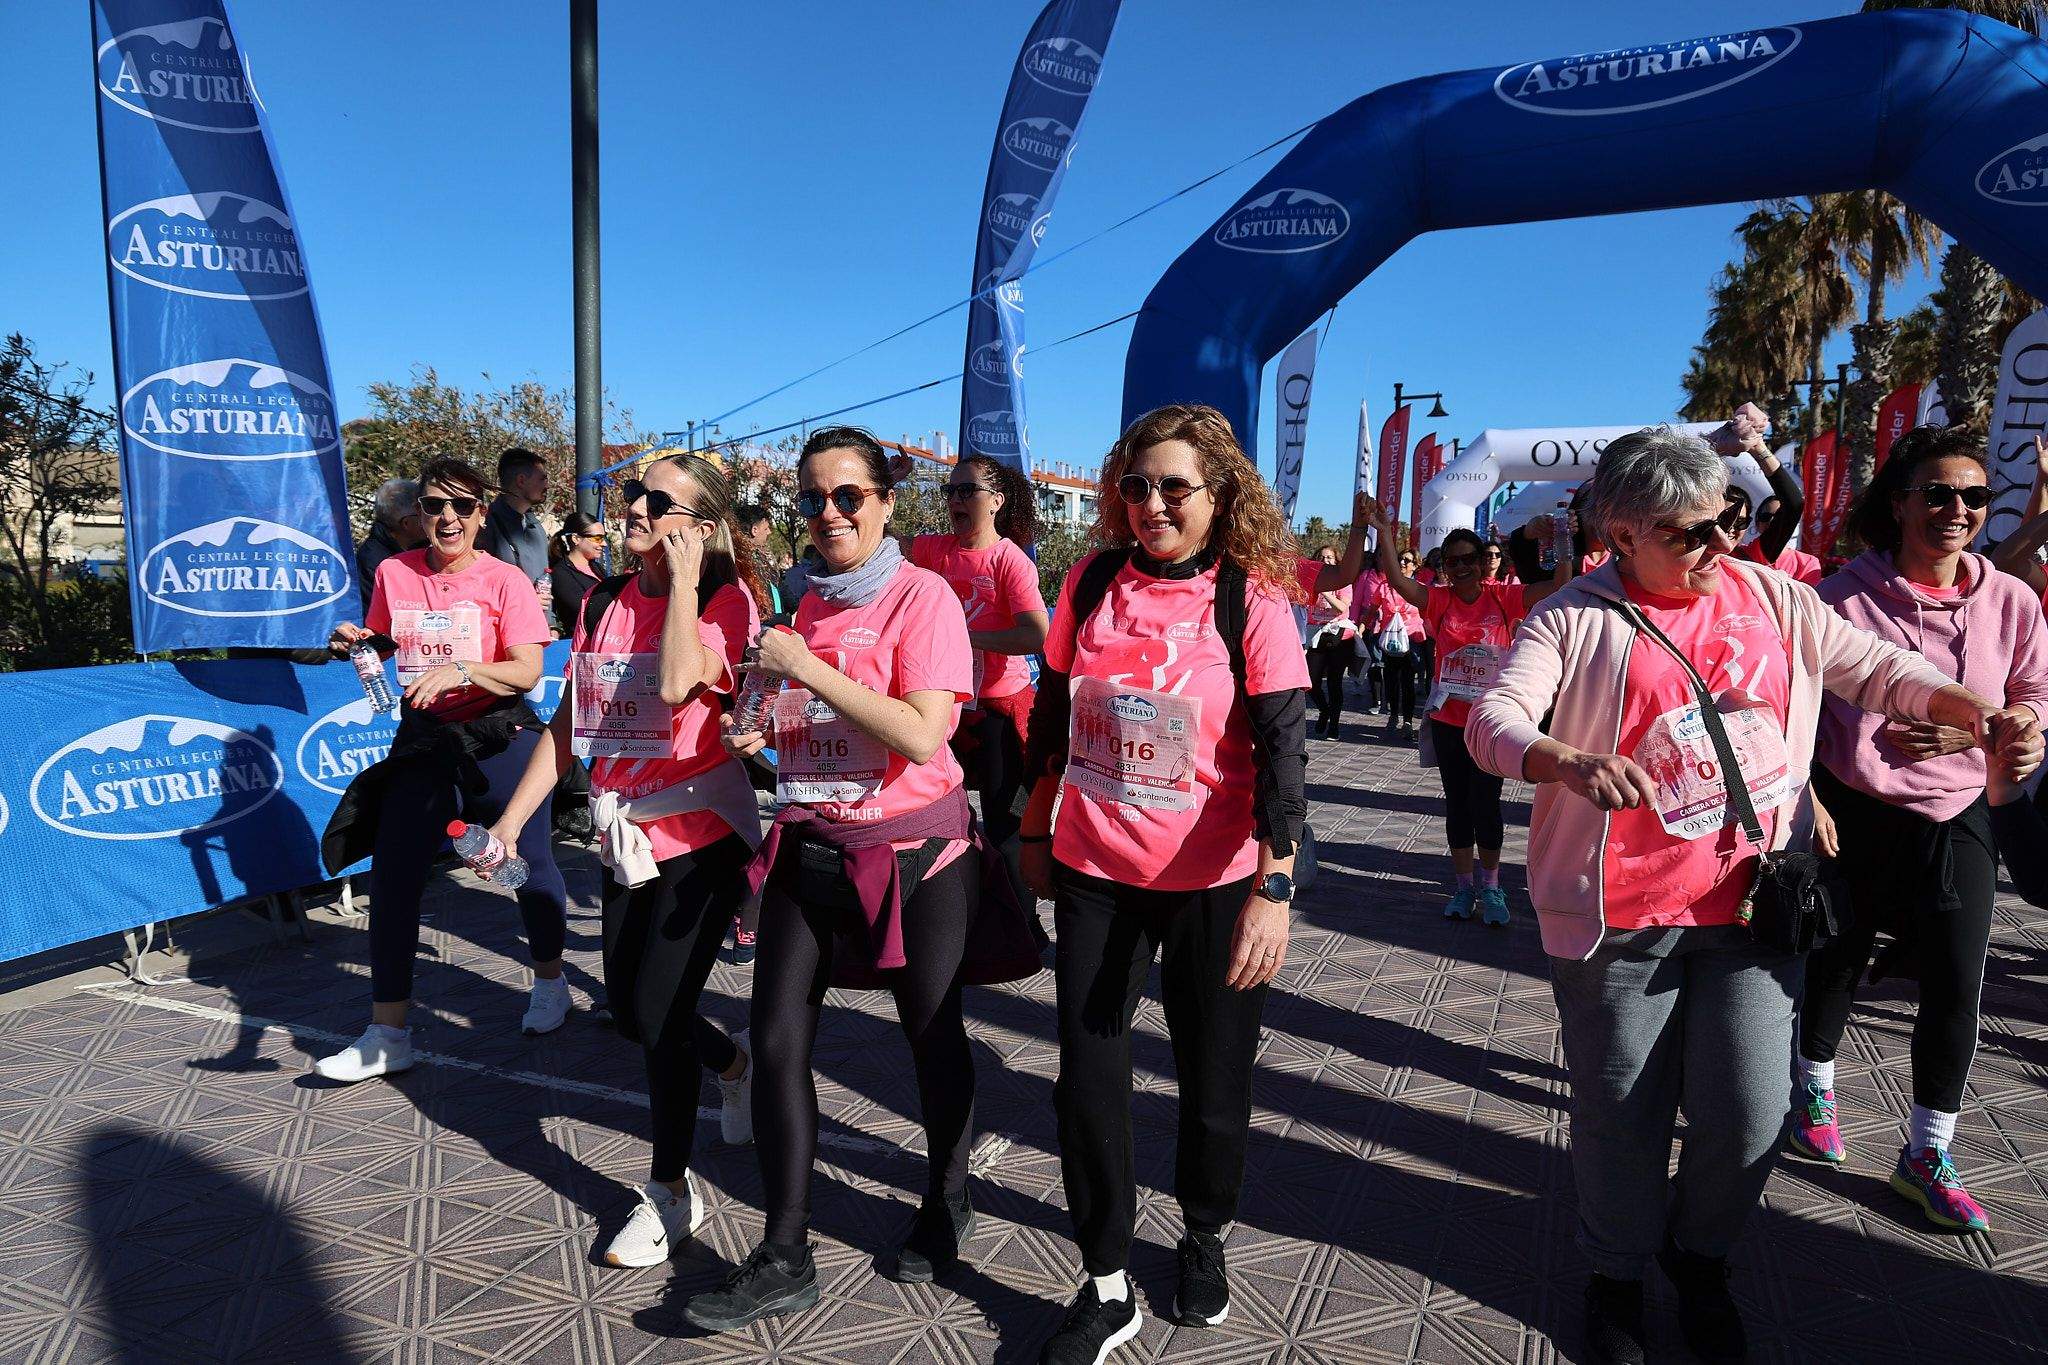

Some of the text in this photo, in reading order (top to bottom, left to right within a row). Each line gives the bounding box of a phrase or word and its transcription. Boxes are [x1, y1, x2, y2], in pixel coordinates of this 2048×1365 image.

[151, 52, 221, 69] CENTRAL
[1514, 35, 1778, 98] ASTURIANA
[159, 224, 239, 240] CENTRAL
[1222, 217, 1338, 241] ASTURIANA
[171, 392, 328, 410] CENTRAL LECHERA
[138, 394, 335, 440] ASTURIANA
[1386, 430, 1402, 502] Santander
[1446, 472, 1488, 482] OYSHO
[187, 552, 329, 565] CENTRAL LECHERA
[155, 556, 335, 595] ASTURIANA
[421, 643, 453, 656] 016
[1463, 665, 1486, 676] 016
[601, 700, 637, 717] 016
[1109, 701, 1154, 718] ASTURIANA
[581, 741, 661, 752] OYSHO Santander
[809, 738, 849, 758] 016
[1109, 736, 1155, 761] 016
[91, 756, 175, 776] CENTRAL
[816, 763, 837, 772] 4052
[1084, 761, 1106, 774] CARRERA
[1106, 768, 1113, 776] DE
[1113, 771, 1121, 779] LA
[1122, 774, 1142, 783] MUJER
[1115, 761, 1137, 772] 4831
[58, 763, 270, 821] ASTURIANA
[787, 786, 820, 796] OYSHO
[1080, 772, 1114, 792] OYSHO
[1137, 790, 1177, 804] Santander
[1679, 801, 1711, 817] CARRERA
[1711, 797, 1721, 807] DE
